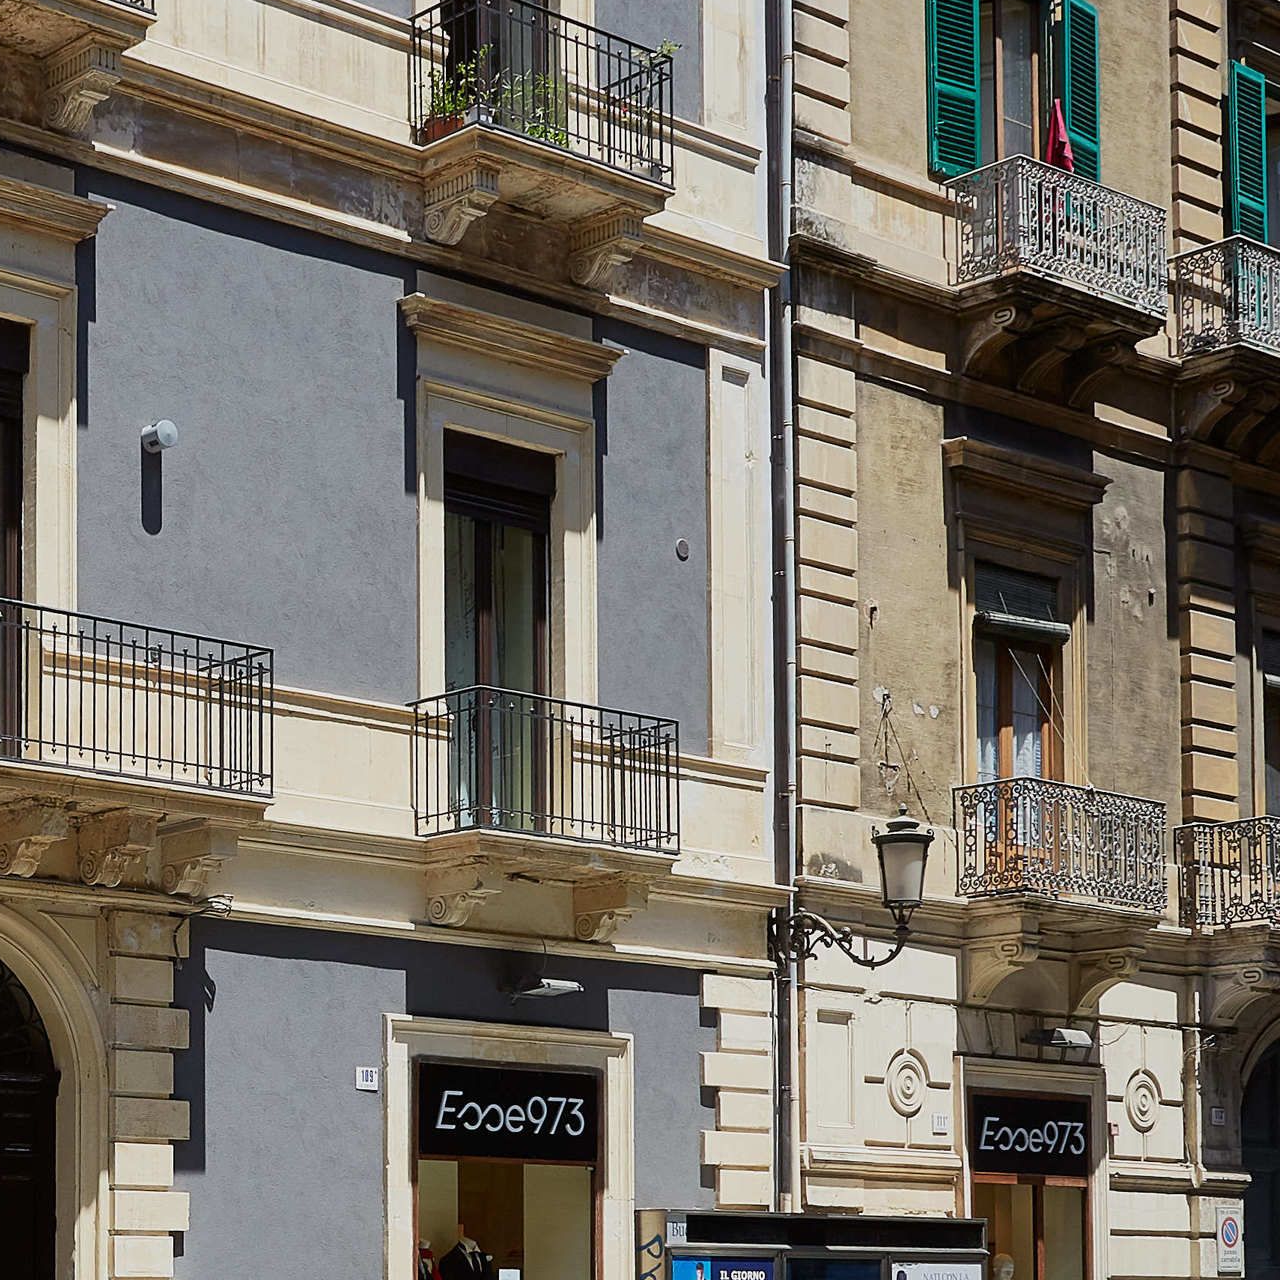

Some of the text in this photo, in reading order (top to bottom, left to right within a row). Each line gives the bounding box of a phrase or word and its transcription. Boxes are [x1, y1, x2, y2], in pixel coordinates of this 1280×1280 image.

[435, 1090, 585, 1137] Esse973
[979, 1116, 1085, 1155] Esse973
[720, 1270, 765, 1280] IL GIORNO
